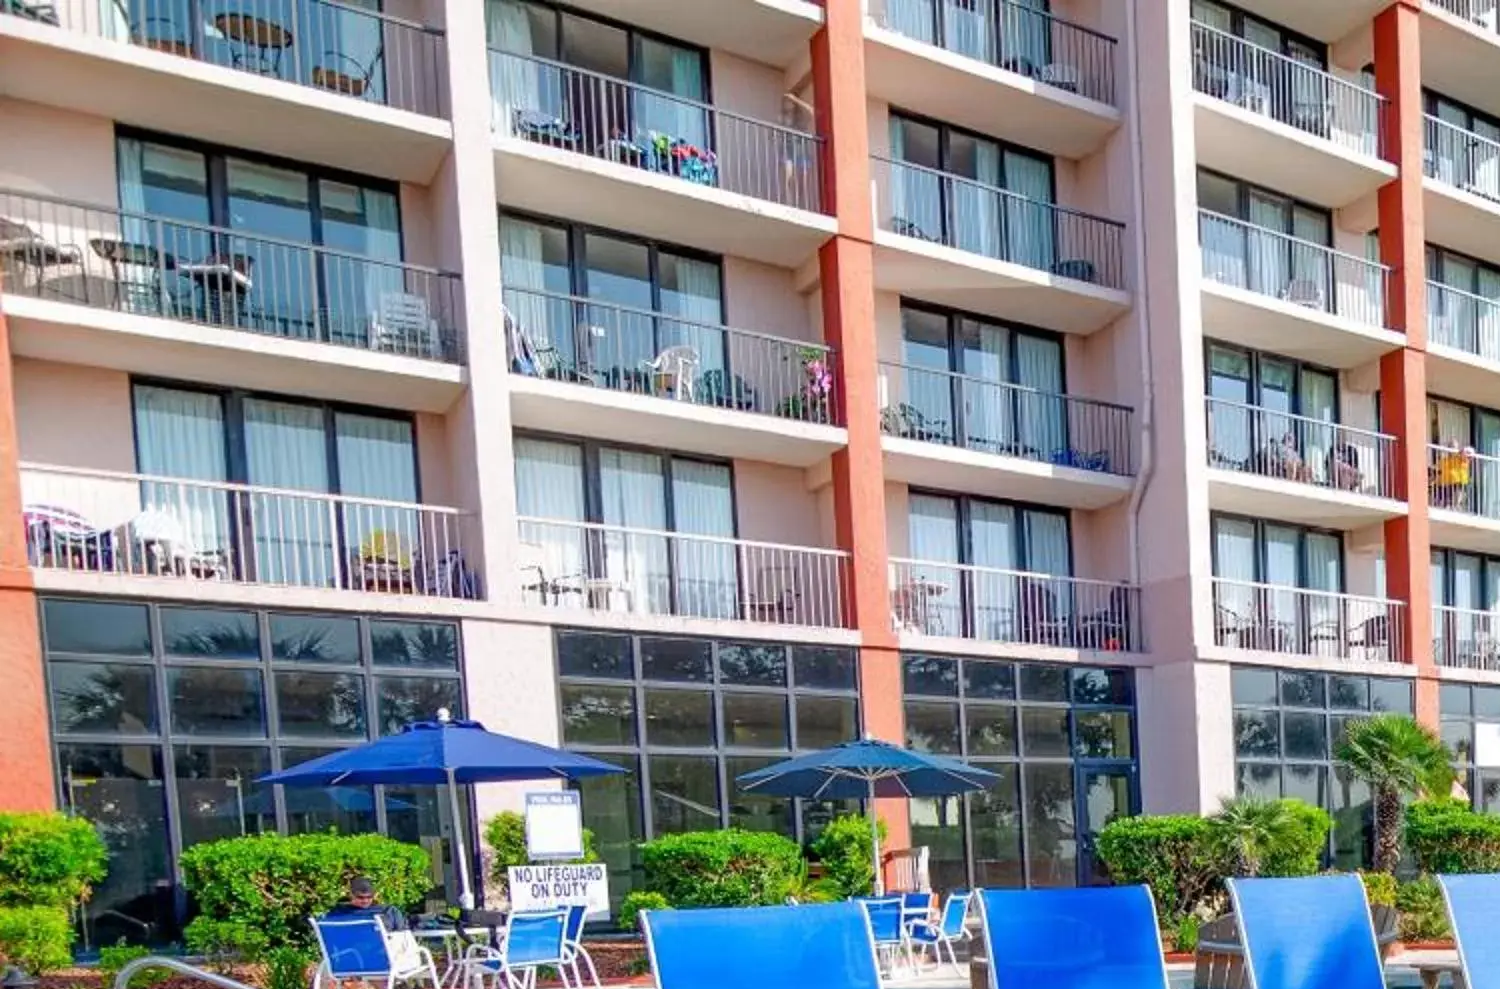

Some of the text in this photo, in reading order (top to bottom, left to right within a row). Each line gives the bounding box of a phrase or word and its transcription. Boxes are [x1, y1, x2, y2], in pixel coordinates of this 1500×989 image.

[515, 866, 602, 883] NO LIFEGUARD
[531, 882, 588, 898] ON DUTY
